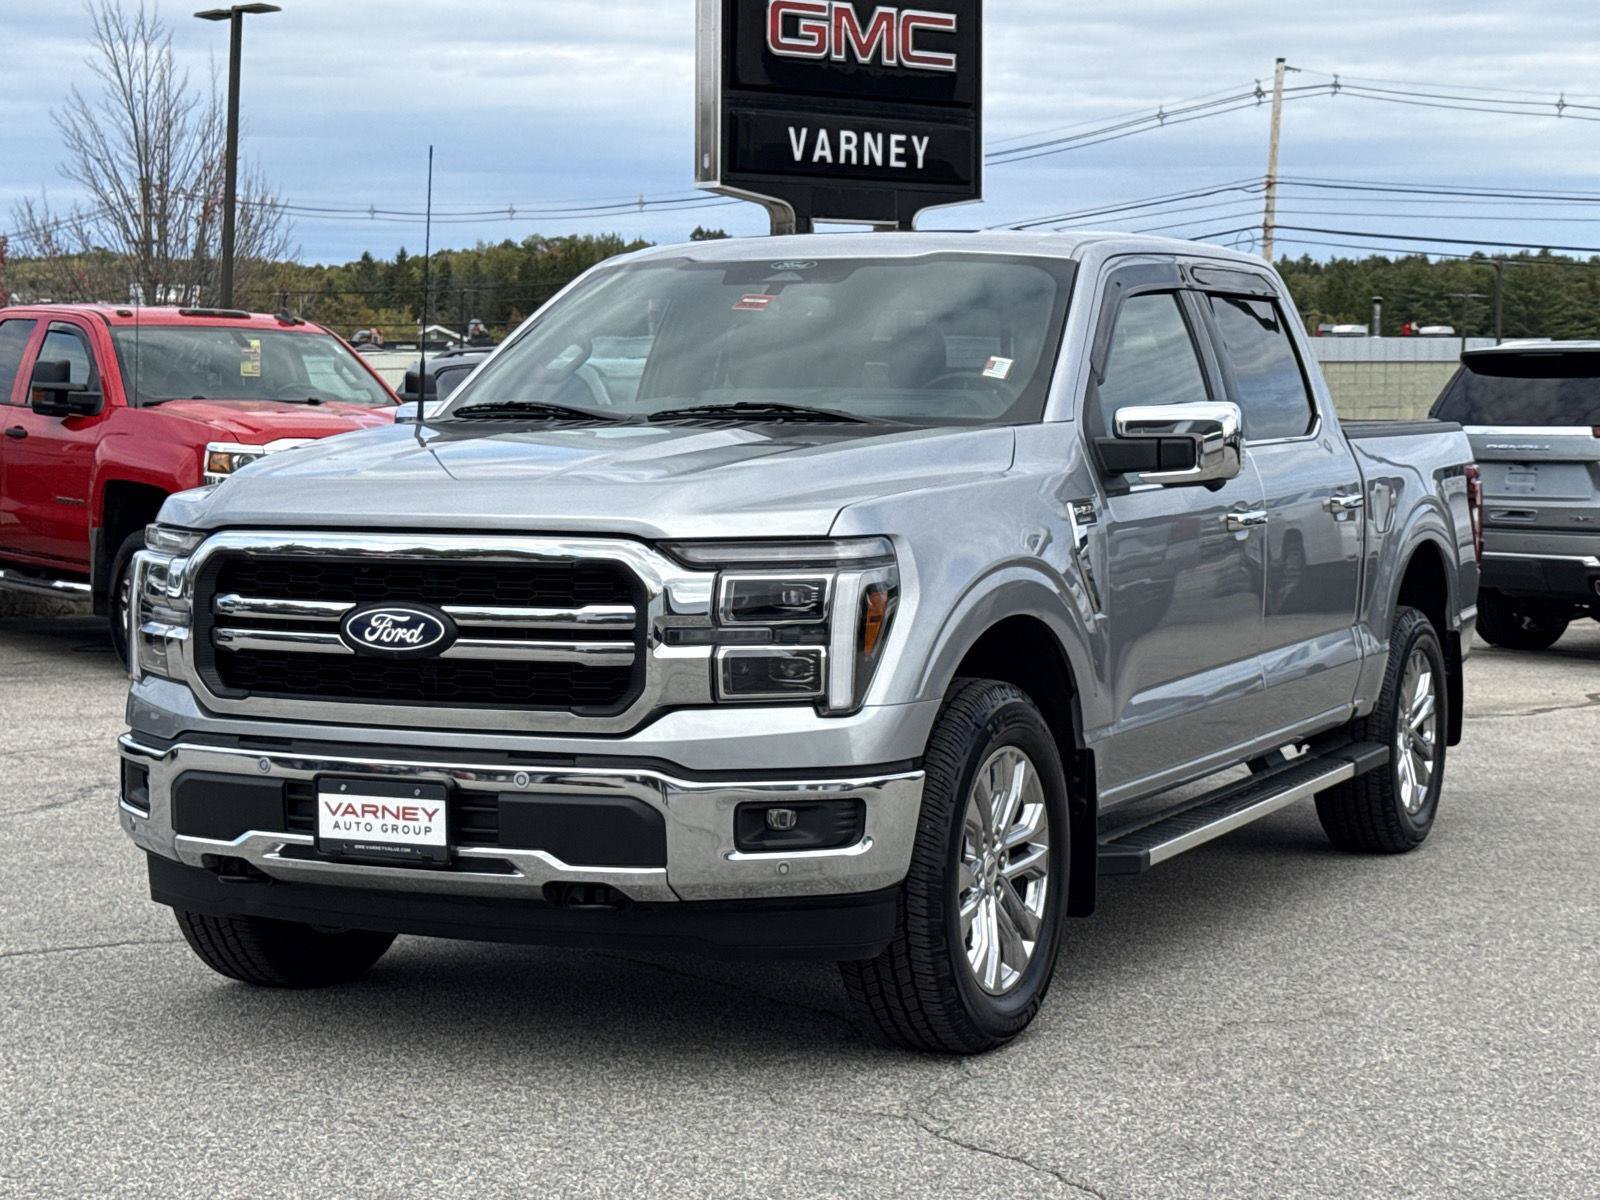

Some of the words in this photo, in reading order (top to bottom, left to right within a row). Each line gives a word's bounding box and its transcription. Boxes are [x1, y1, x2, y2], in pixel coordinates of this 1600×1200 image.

[767, 0, 957, 72] GMC
[788, 126, 930, 169] VARNEY
[364, 613, 426, 643] Ford
[324, 801, 440, 822] VARNEY
[333, 820, 373, 832] AUTO
[380, 823, 432, 836] GROUP
